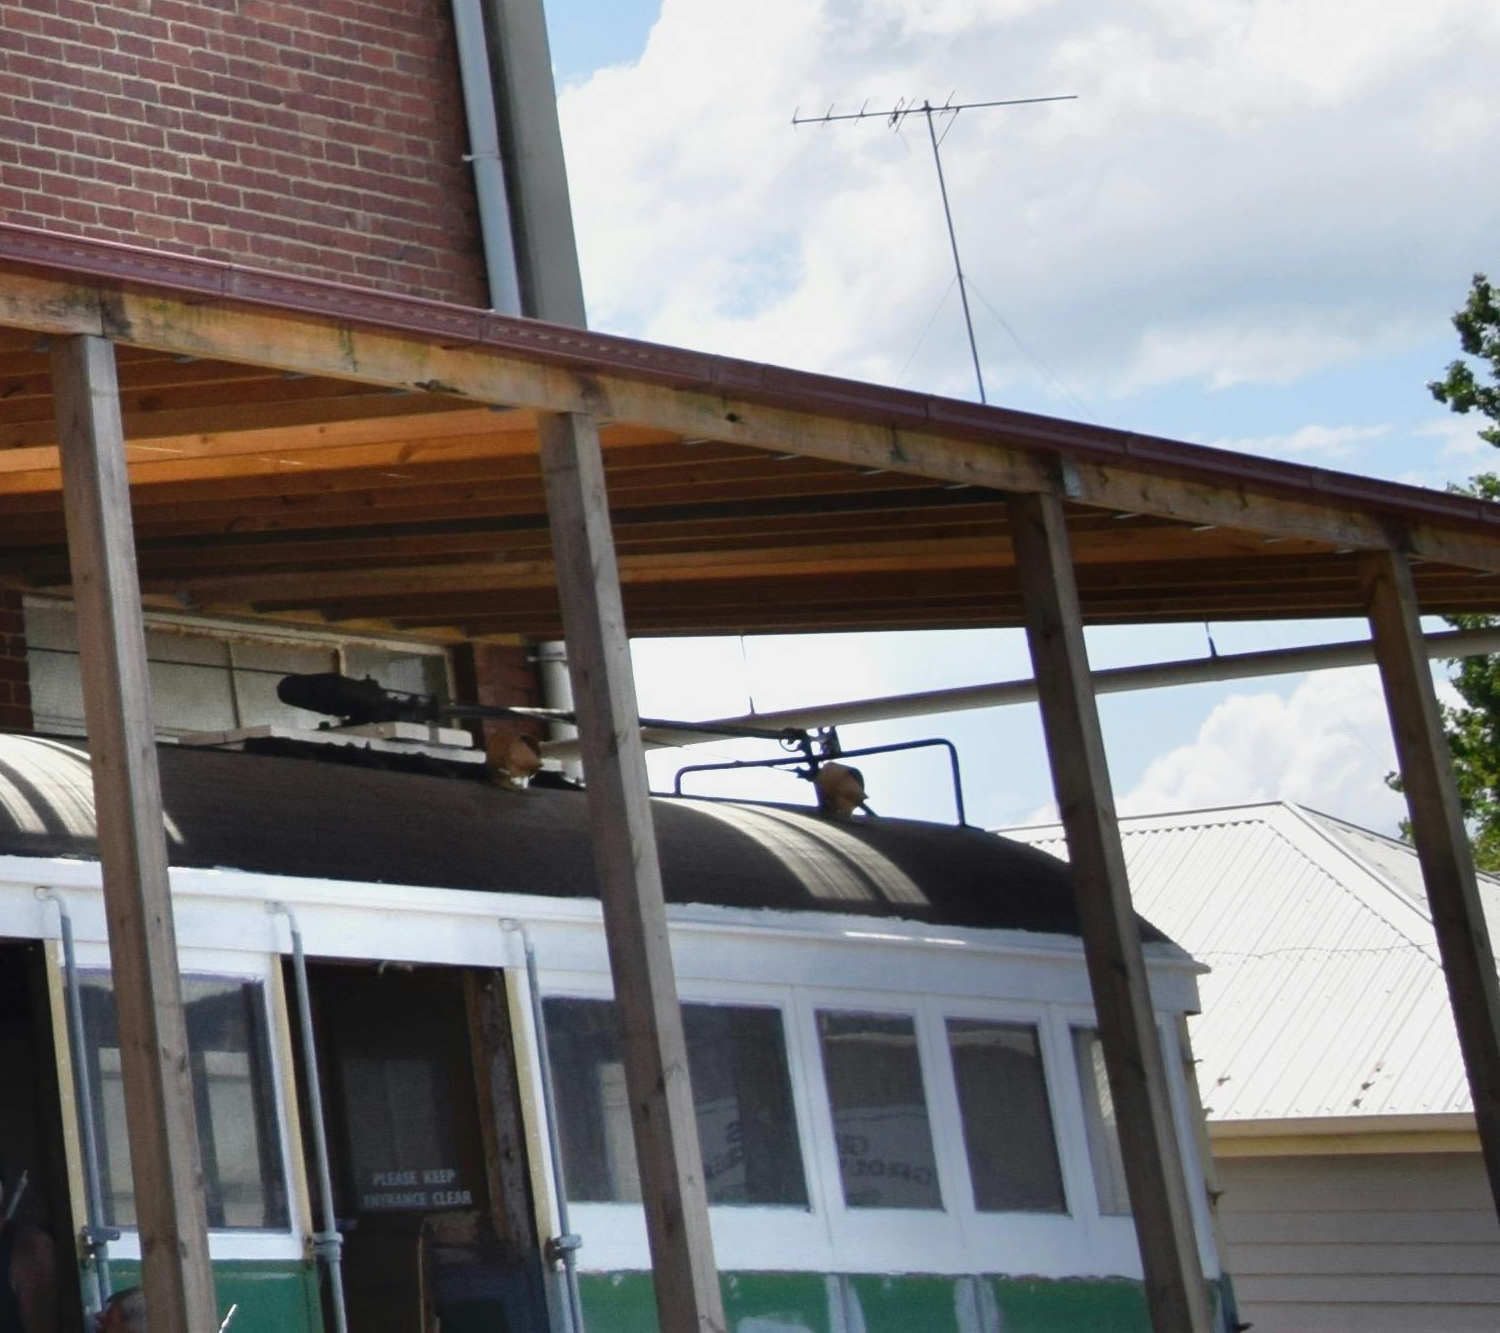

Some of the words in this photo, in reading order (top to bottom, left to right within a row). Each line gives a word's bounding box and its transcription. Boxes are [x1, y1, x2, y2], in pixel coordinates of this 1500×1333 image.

[372, 1171, 418, 1186] PLEASE
[423, 1169, 455, 1184] KEEP
[363, 1192, 427, 1208] ENTRANCE
[432, 1190, 473, 1206] CLEAR
